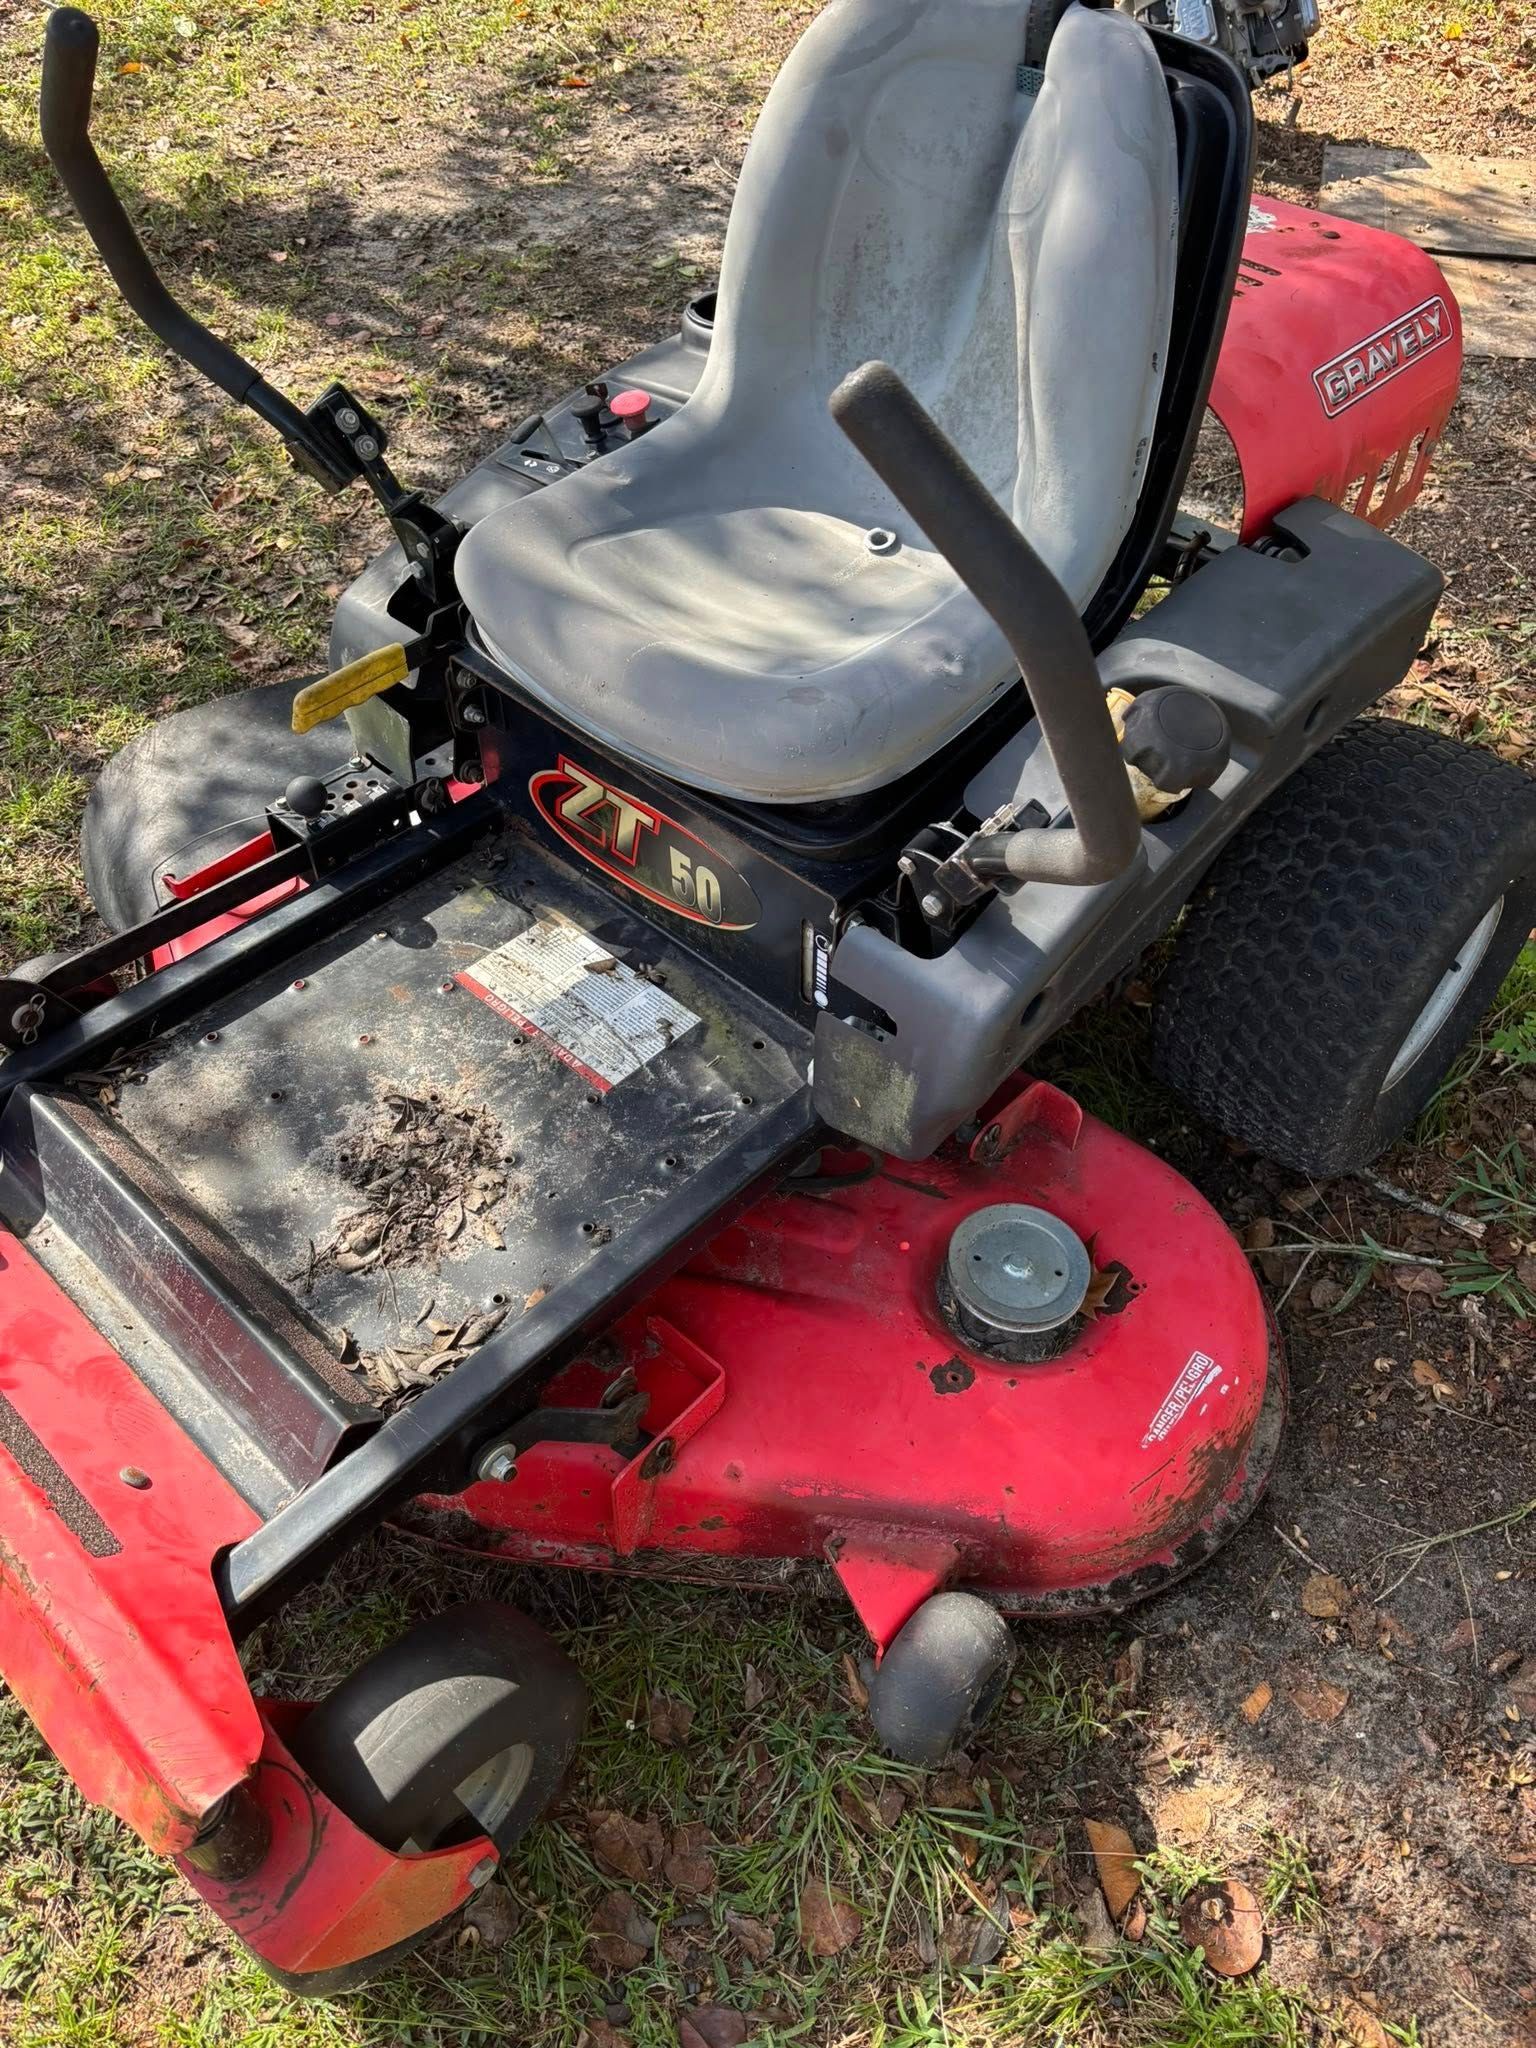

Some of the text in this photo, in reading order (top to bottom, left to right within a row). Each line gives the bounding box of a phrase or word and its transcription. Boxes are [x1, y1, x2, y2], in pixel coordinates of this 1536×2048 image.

[1323, 304, 1442, 405] GRAVELY
[555, 753, 722, 923] ZT 50
[484, 993, 526, 1027] PELIGRO
